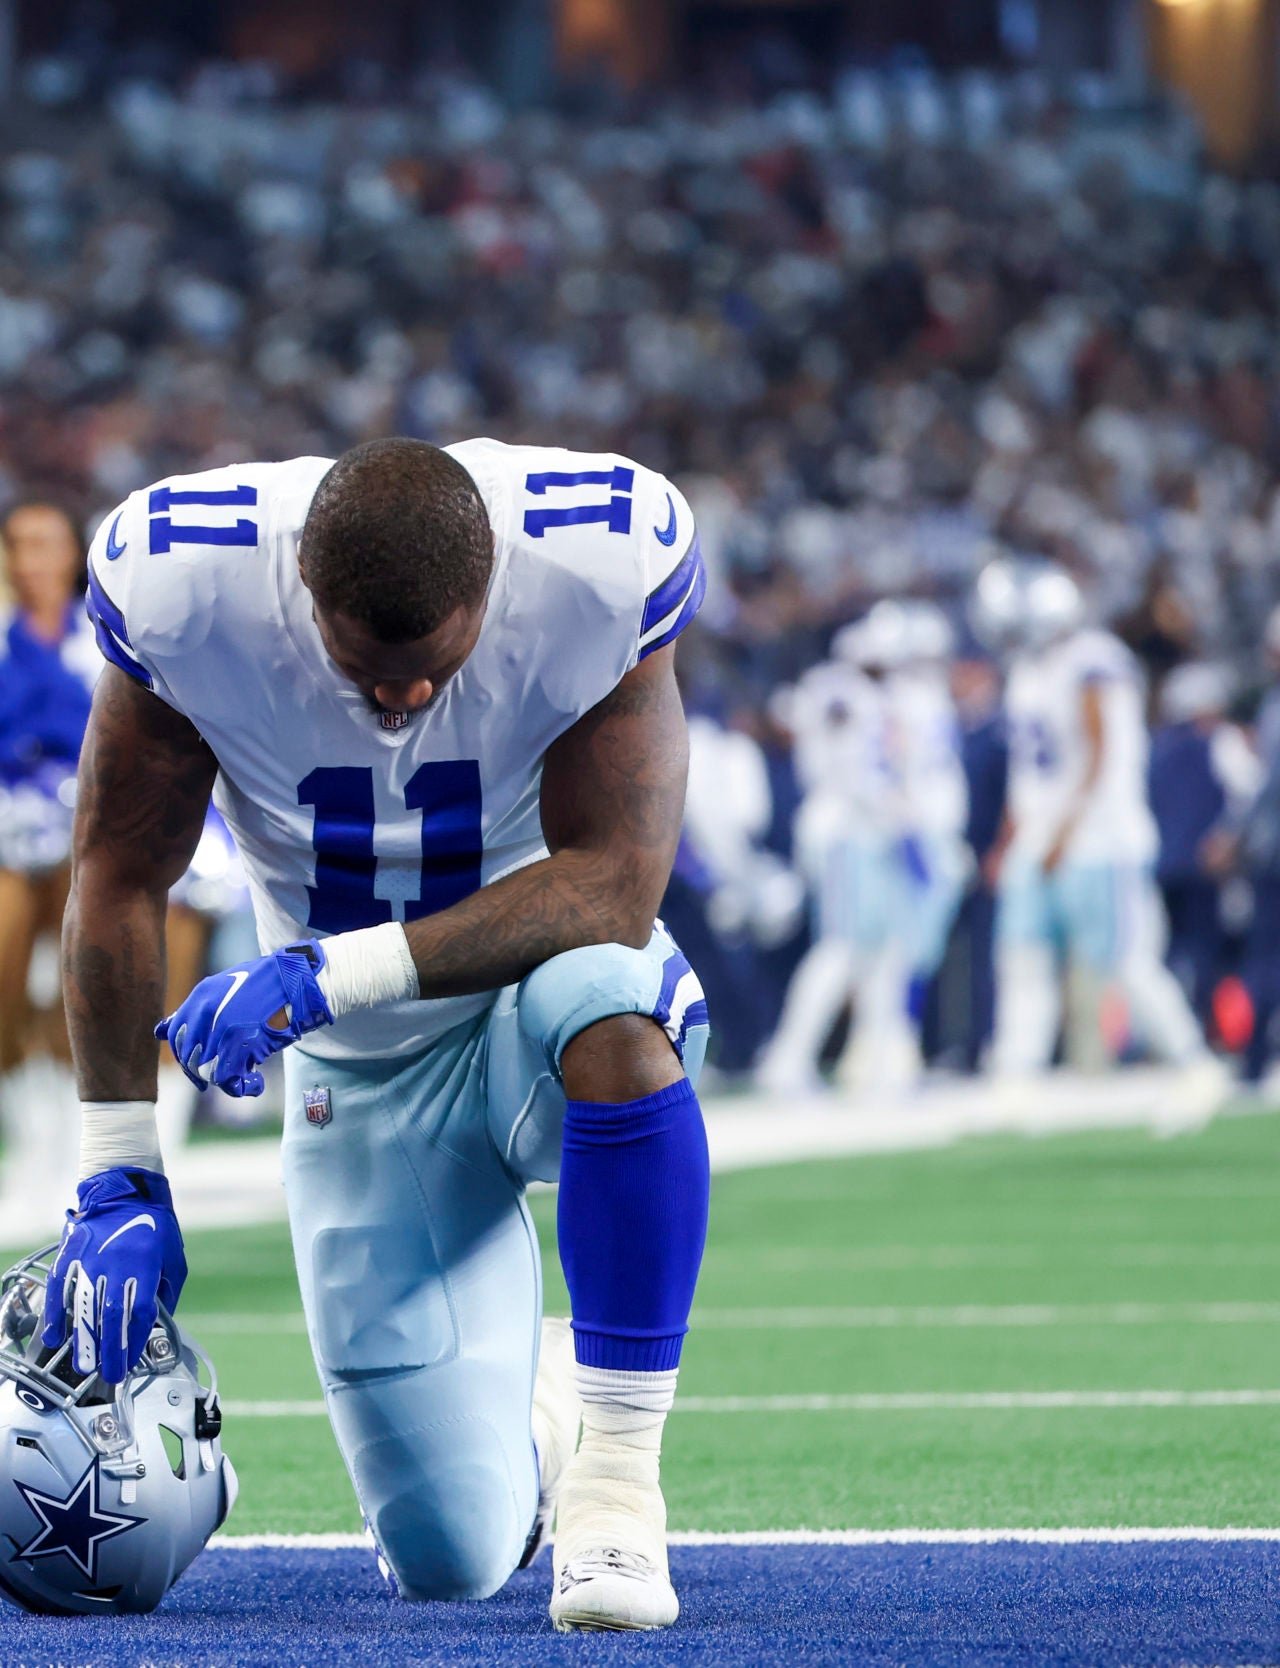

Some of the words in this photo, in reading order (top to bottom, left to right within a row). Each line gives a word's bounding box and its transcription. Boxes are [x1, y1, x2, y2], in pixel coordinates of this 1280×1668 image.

[149, 485, 258, 555] 11
[523, 465, 635, 538] 11
[384, 711, 407, 727] NFL
[297, 760, 483, 934] 11
[308, 1104, 327, 1120] NFL
